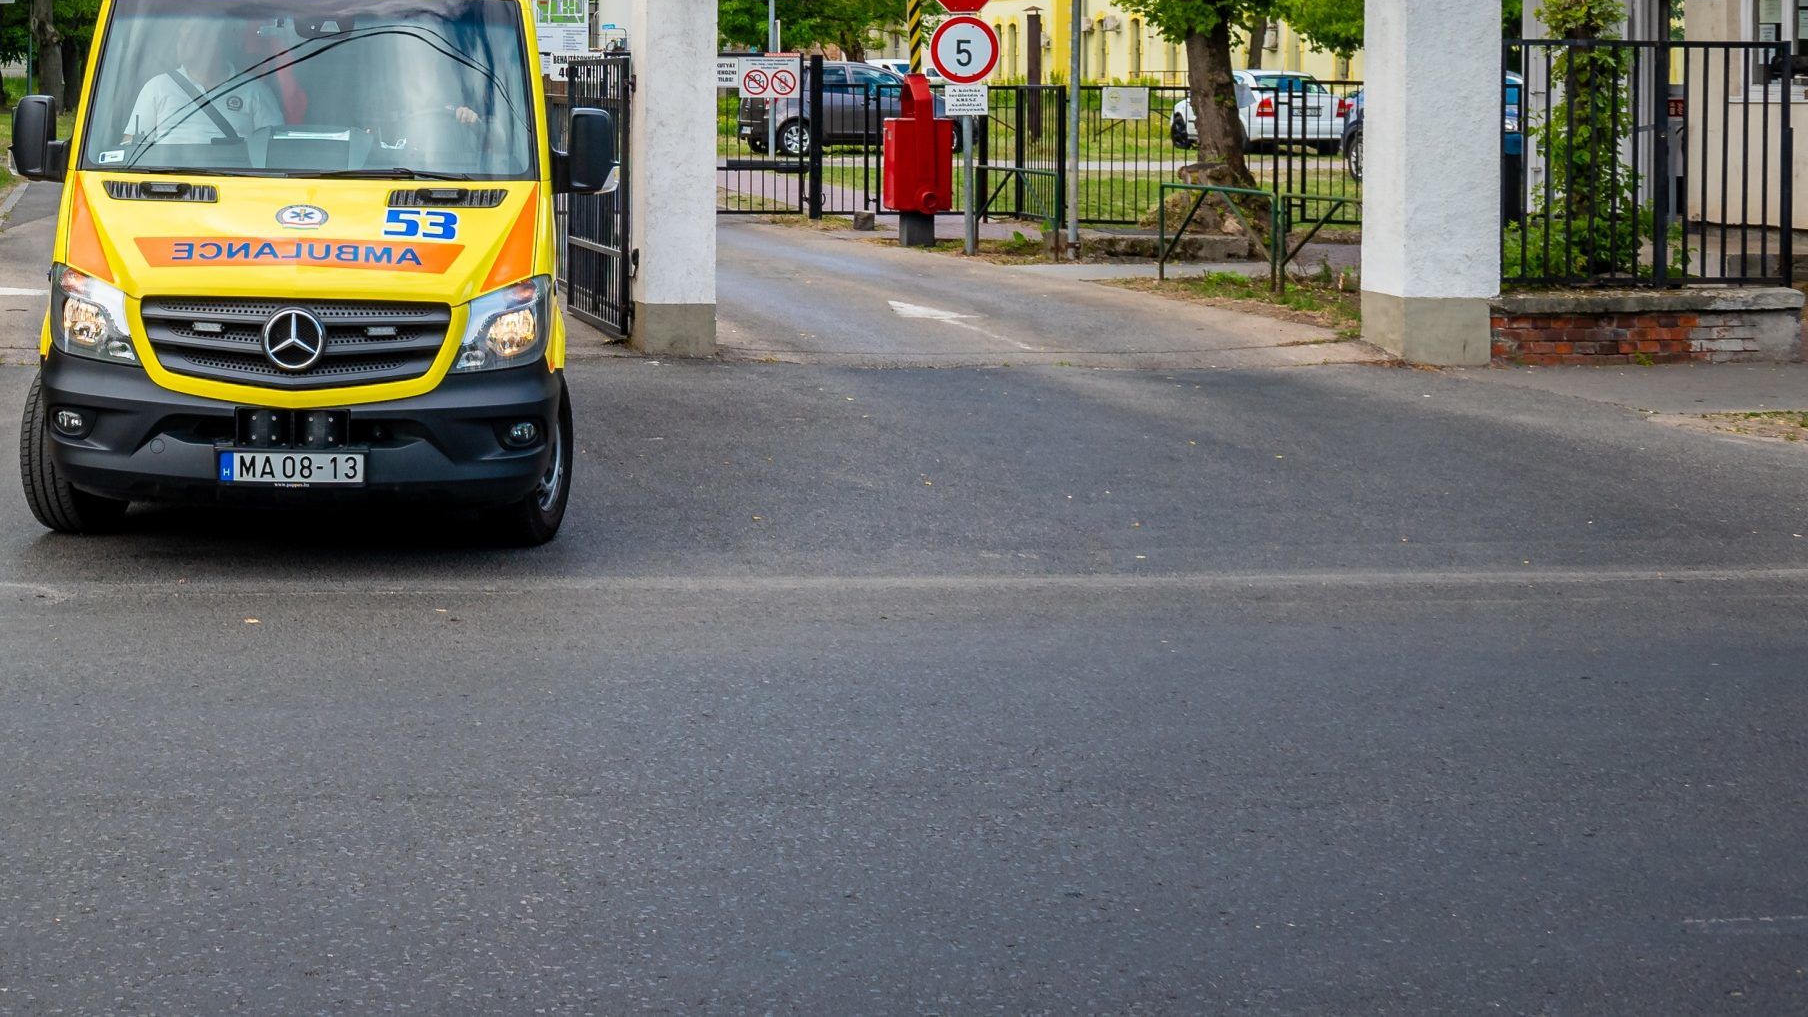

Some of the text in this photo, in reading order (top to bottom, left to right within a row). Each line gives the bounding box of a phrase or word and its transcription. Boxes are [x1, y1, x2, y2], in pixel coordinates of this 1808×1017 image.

[956, 39, 972, 67] 5
[384, 209, 458, 240] 53
[223, 468, 230, 476] H
